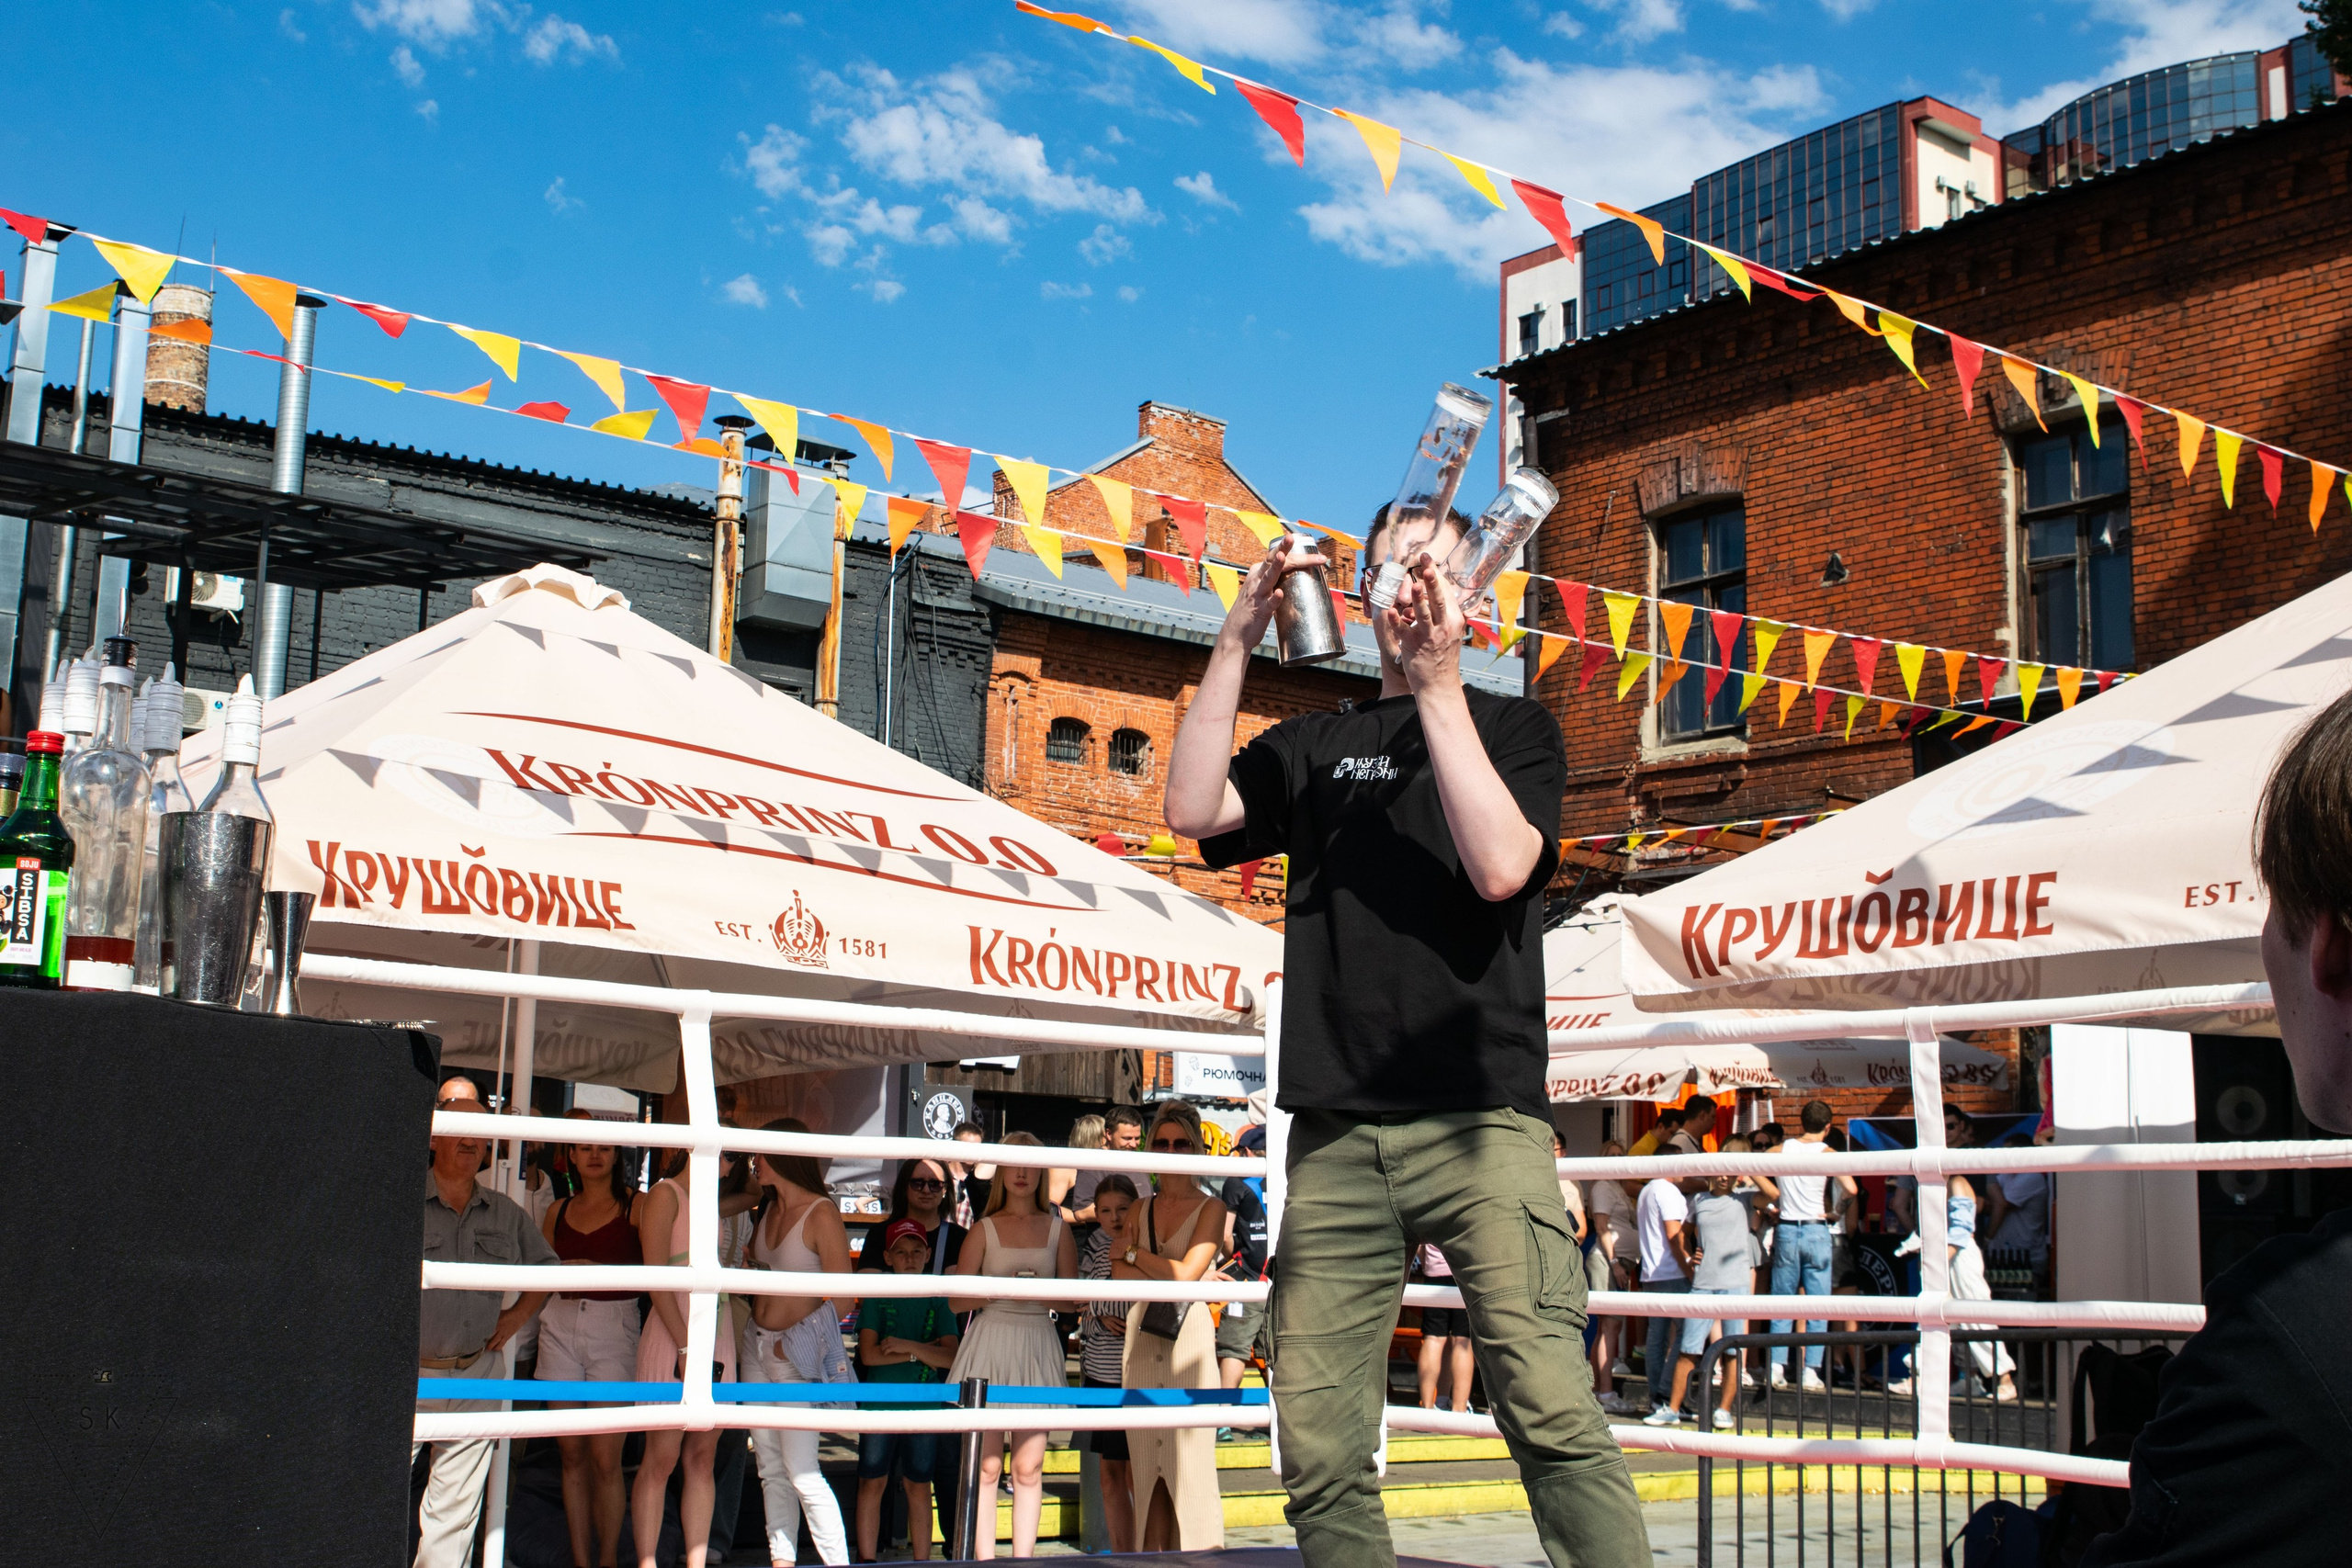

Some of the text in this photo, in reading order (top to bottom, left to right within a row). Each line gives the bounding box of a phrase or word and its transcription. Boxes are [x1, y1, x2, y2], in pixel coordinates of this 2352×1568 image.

[19, 860, 40, 869] SOJU
[2184, 881, 2256, 908] EST.
[715, 920, 888, 960] EST. 1581
